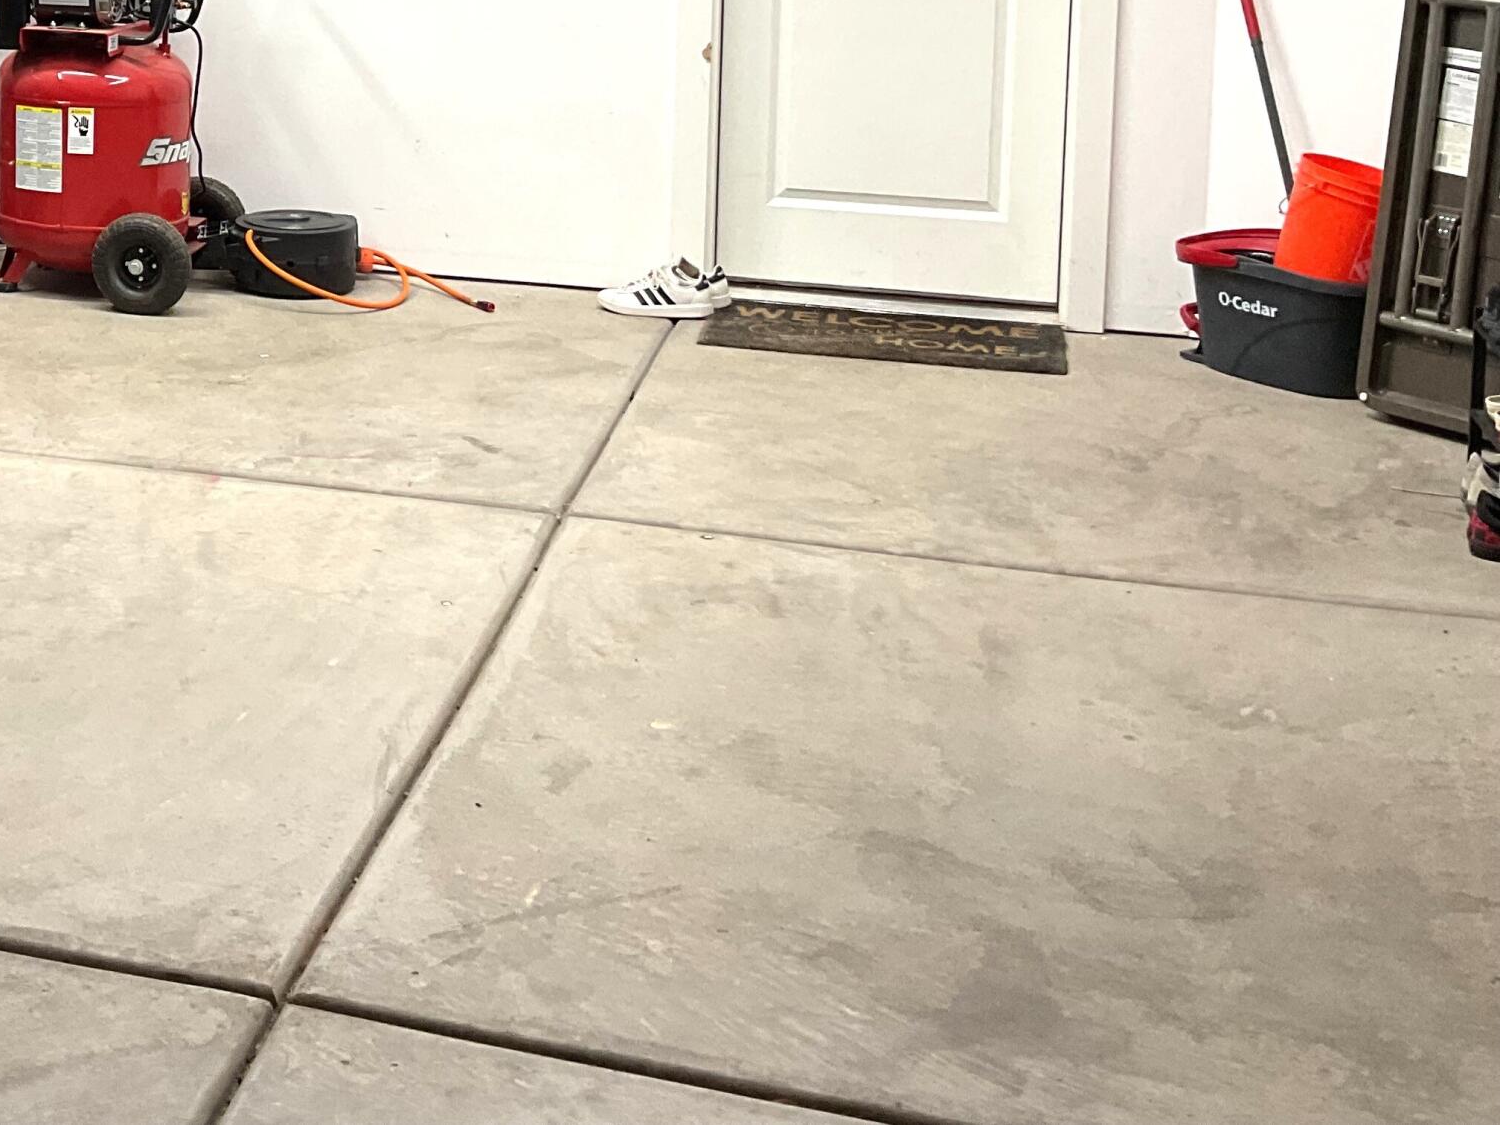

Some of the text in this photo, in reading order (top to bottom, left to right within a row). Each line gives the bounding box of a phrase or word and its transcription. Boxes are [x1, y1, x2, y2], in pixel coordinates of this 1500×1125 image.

[139, 137, 190, 166] Sna
[737, 305, 1041, 339] WELCOME
[874, 334, 1019, 356] HOME
